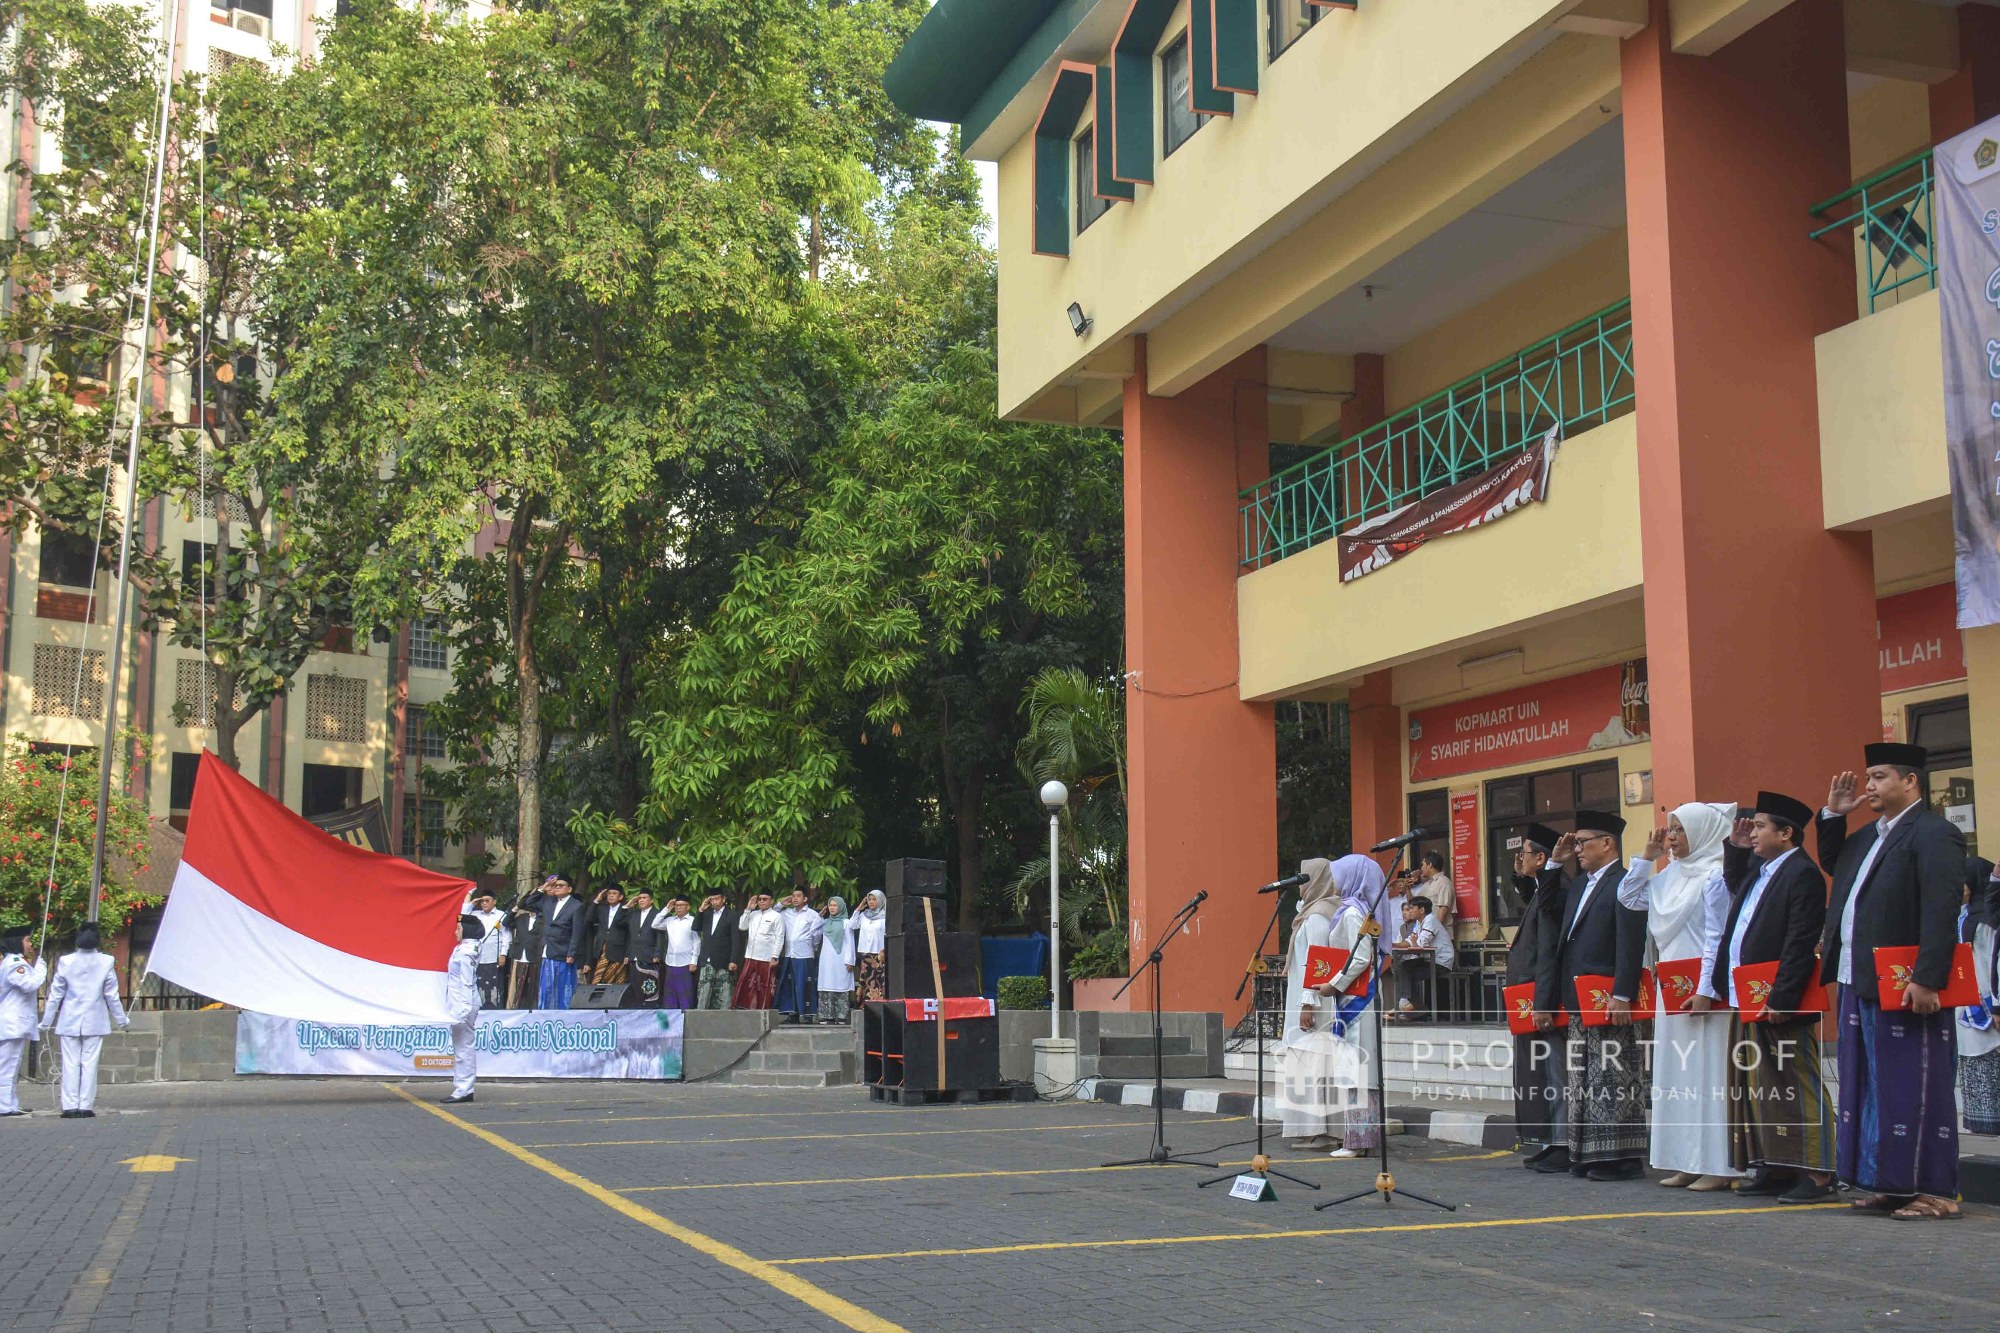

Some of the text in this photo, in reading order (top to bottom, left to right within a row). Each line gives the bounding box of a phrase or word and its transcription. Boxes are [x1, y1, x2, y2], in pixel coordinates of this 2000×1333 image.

[1455, 700, 1540, 734] KOPMART UIN
[1431, 718, 1569, 761] SYARIF HIDAYATULLAH
[296, 1019, 361, 1056] Upacara
[361, 1024, 449, 1058] Peringatan
[488, 1020, 541, 1055] Santri
[540, 1019, 618, 1055] Nasional
